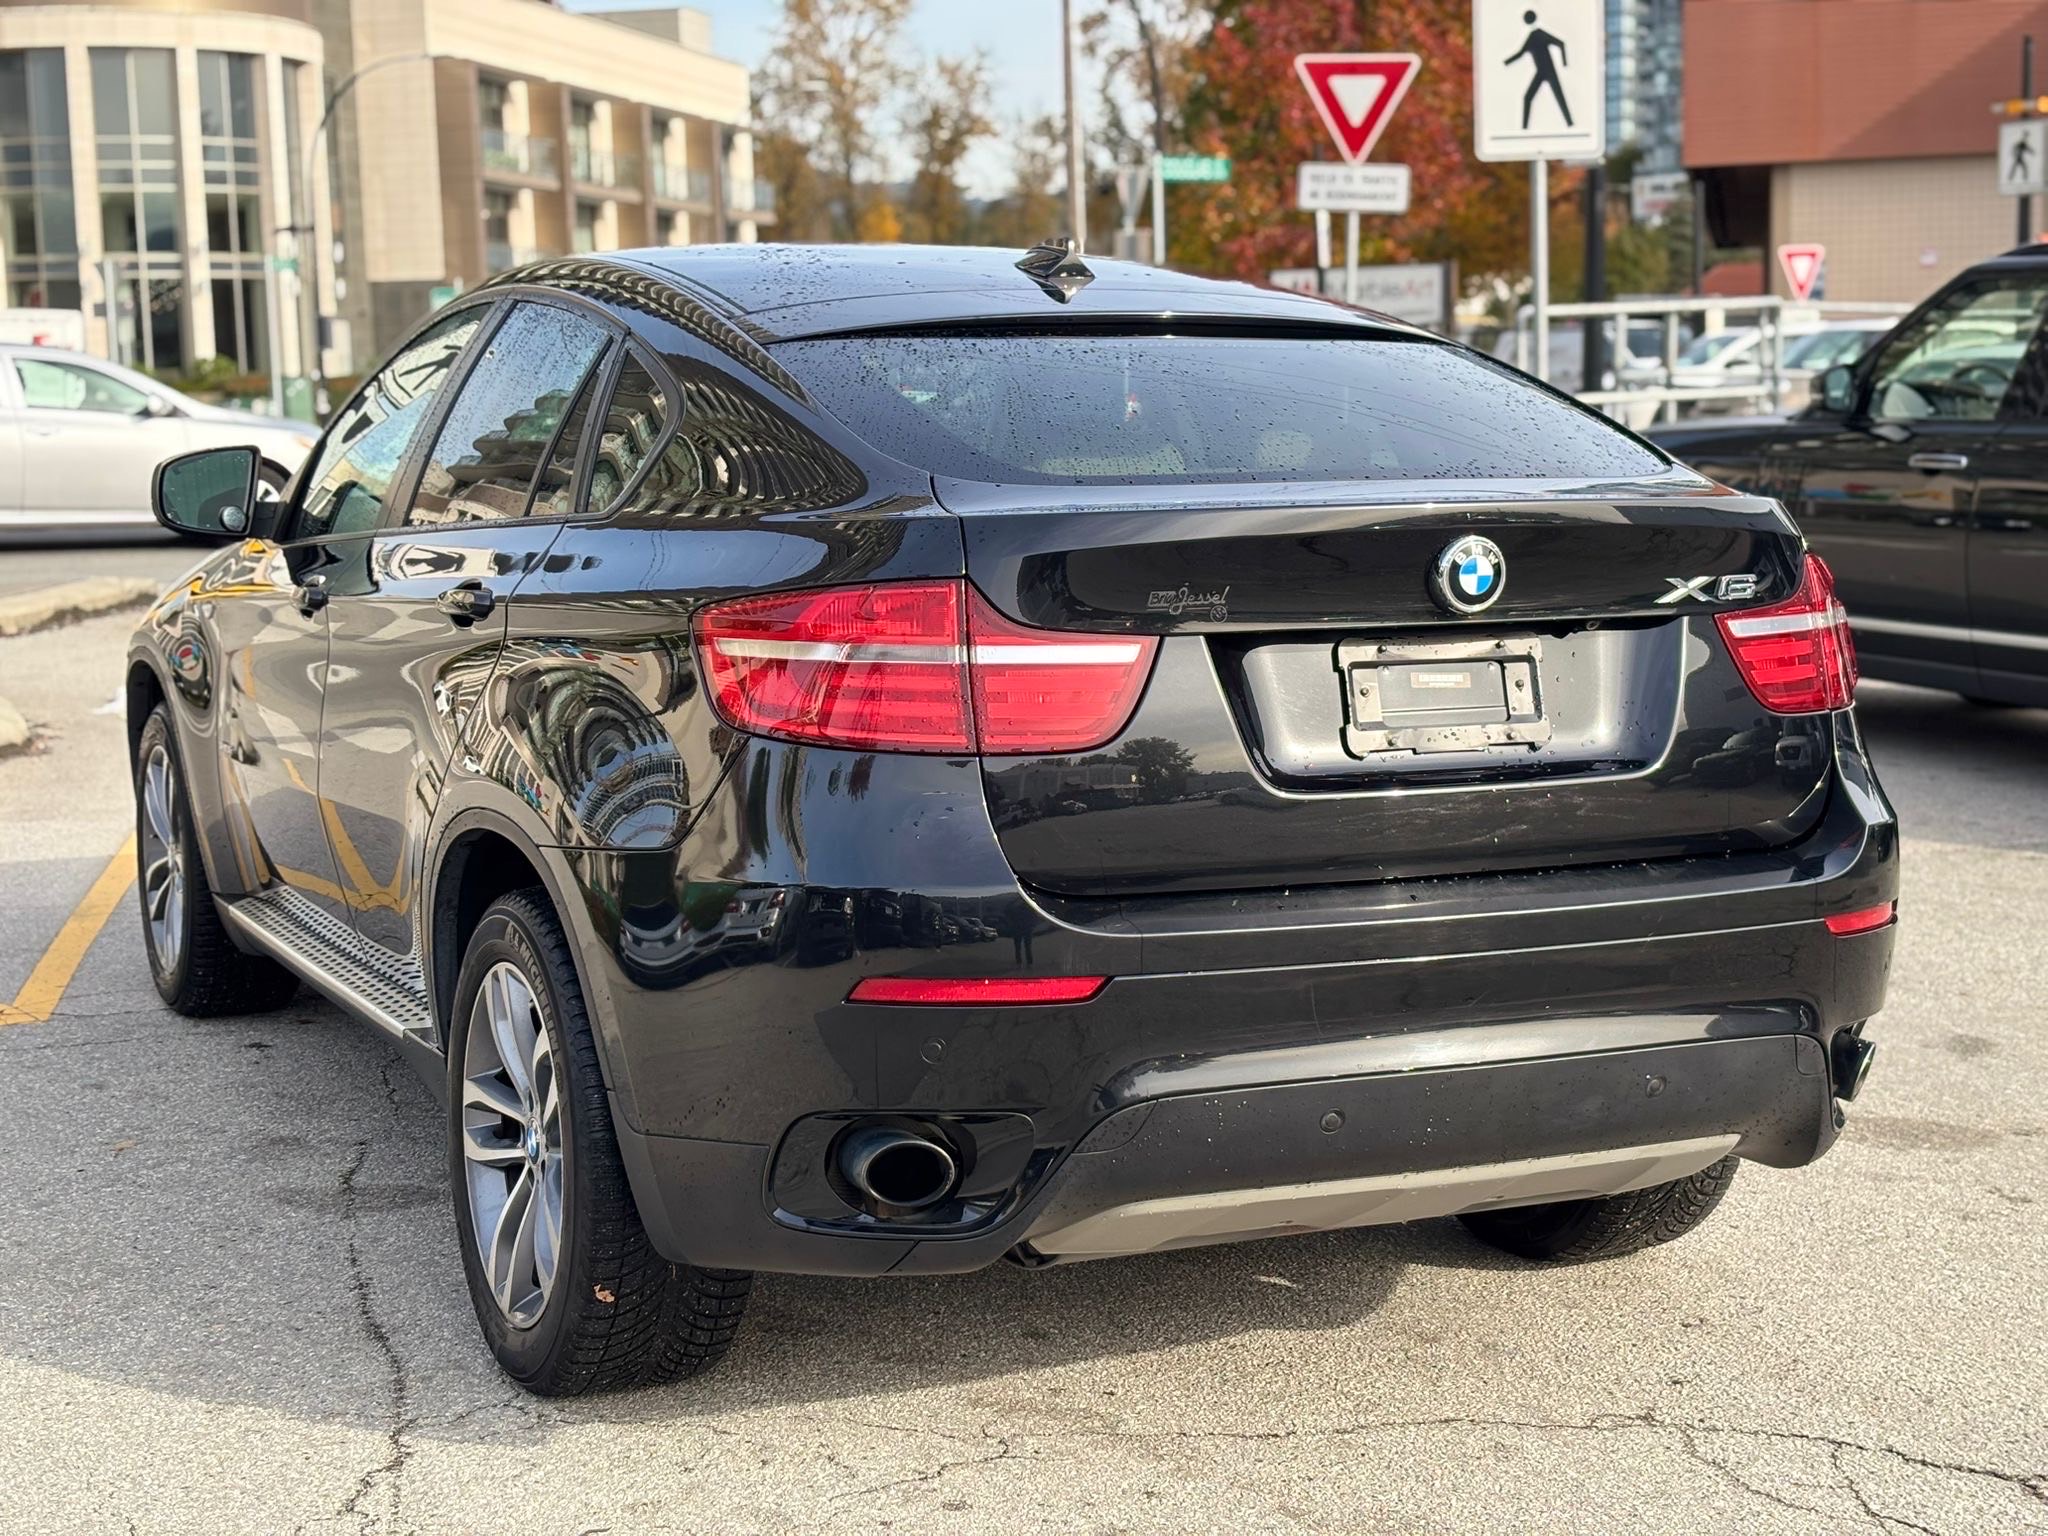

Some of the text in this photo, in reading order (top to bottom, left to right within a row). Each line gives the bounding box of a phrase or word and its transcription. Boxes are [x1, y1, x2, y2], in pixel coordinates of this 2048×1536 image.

[1454, 544, 1499, 566] BMW
[1169, 582, 1230, 615] Jessel
[1653, 574, 1757, 603] X6
[519, 943, 561, 1051] MICHELIN
